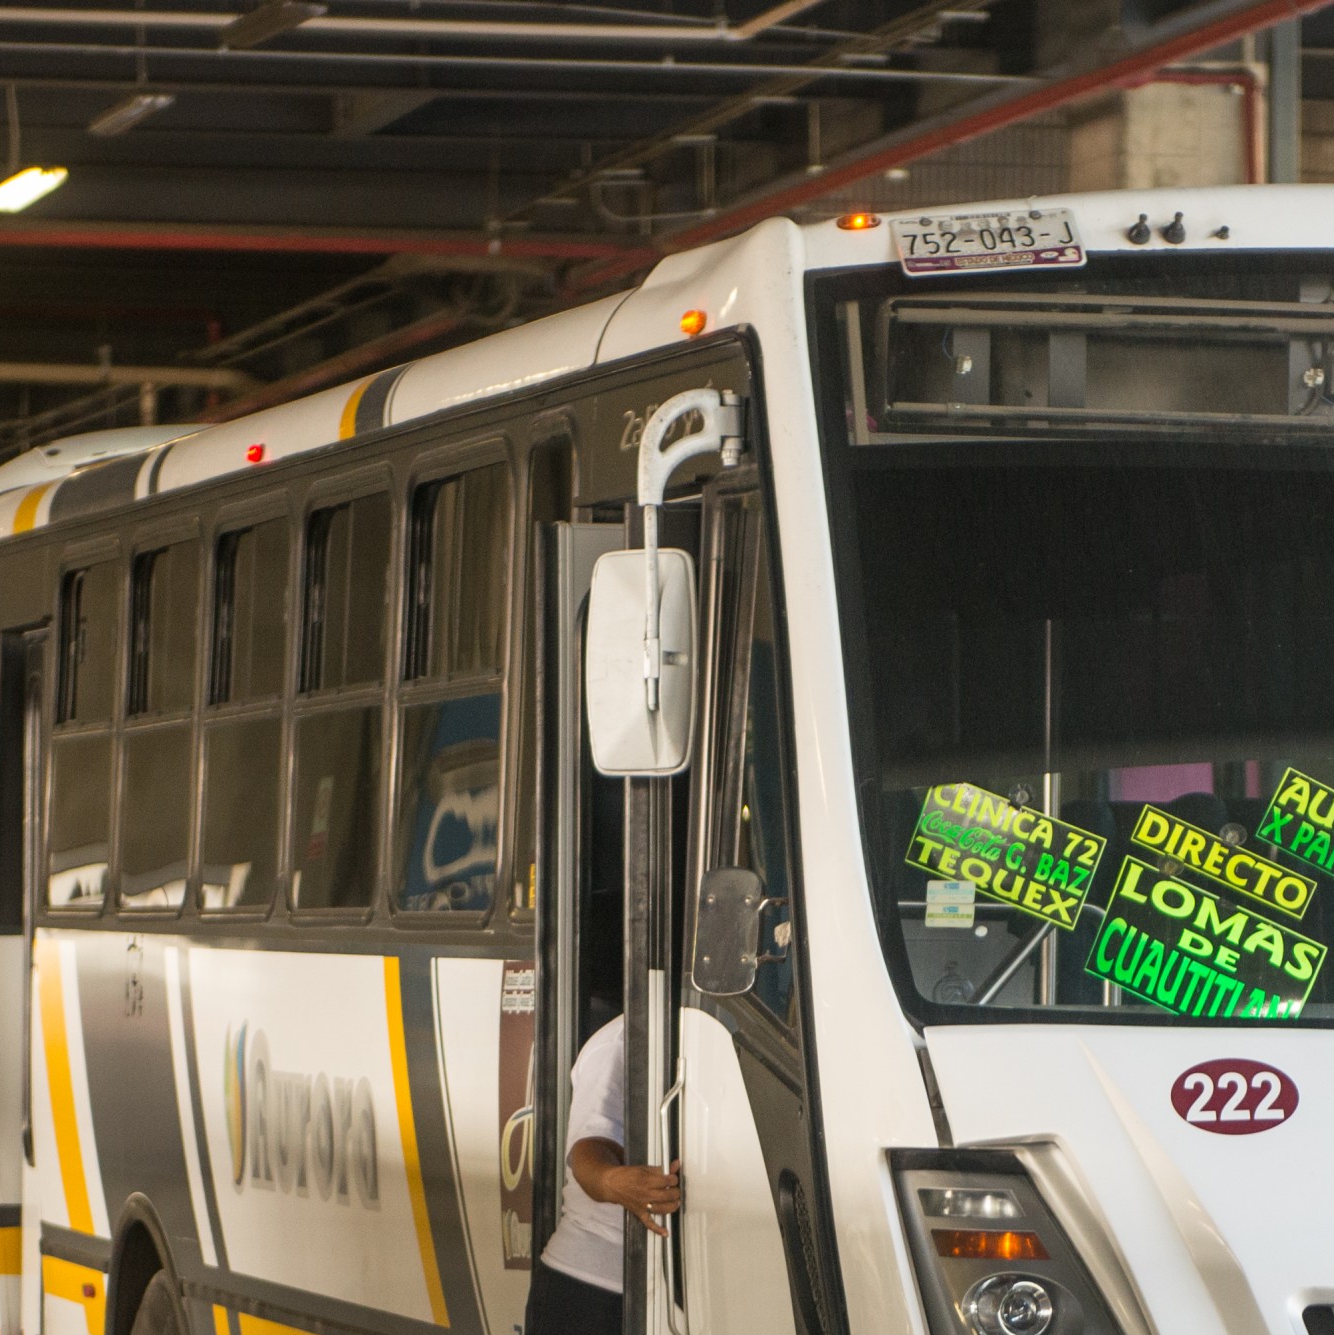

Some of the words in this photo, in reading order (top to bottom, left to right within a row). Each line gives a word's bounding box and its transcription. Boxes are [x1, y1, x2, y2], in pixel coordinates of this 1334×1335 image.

[933, 783, 1054, 849] CLINICA
[1063, 832, 1099, 866] 72
[1261, 806, 1292, 844] X
[915, 835, 1079, 924] TEQUEX
[1033, 852, 1091, 897] BAZ
[1136, 810, 1308, 910] DIRECTO
[1119, 862, 1321, 981] LOMAS
[1177, 928, 1241, 973] DE
[1183, 1070, 1285, 1122] 222
